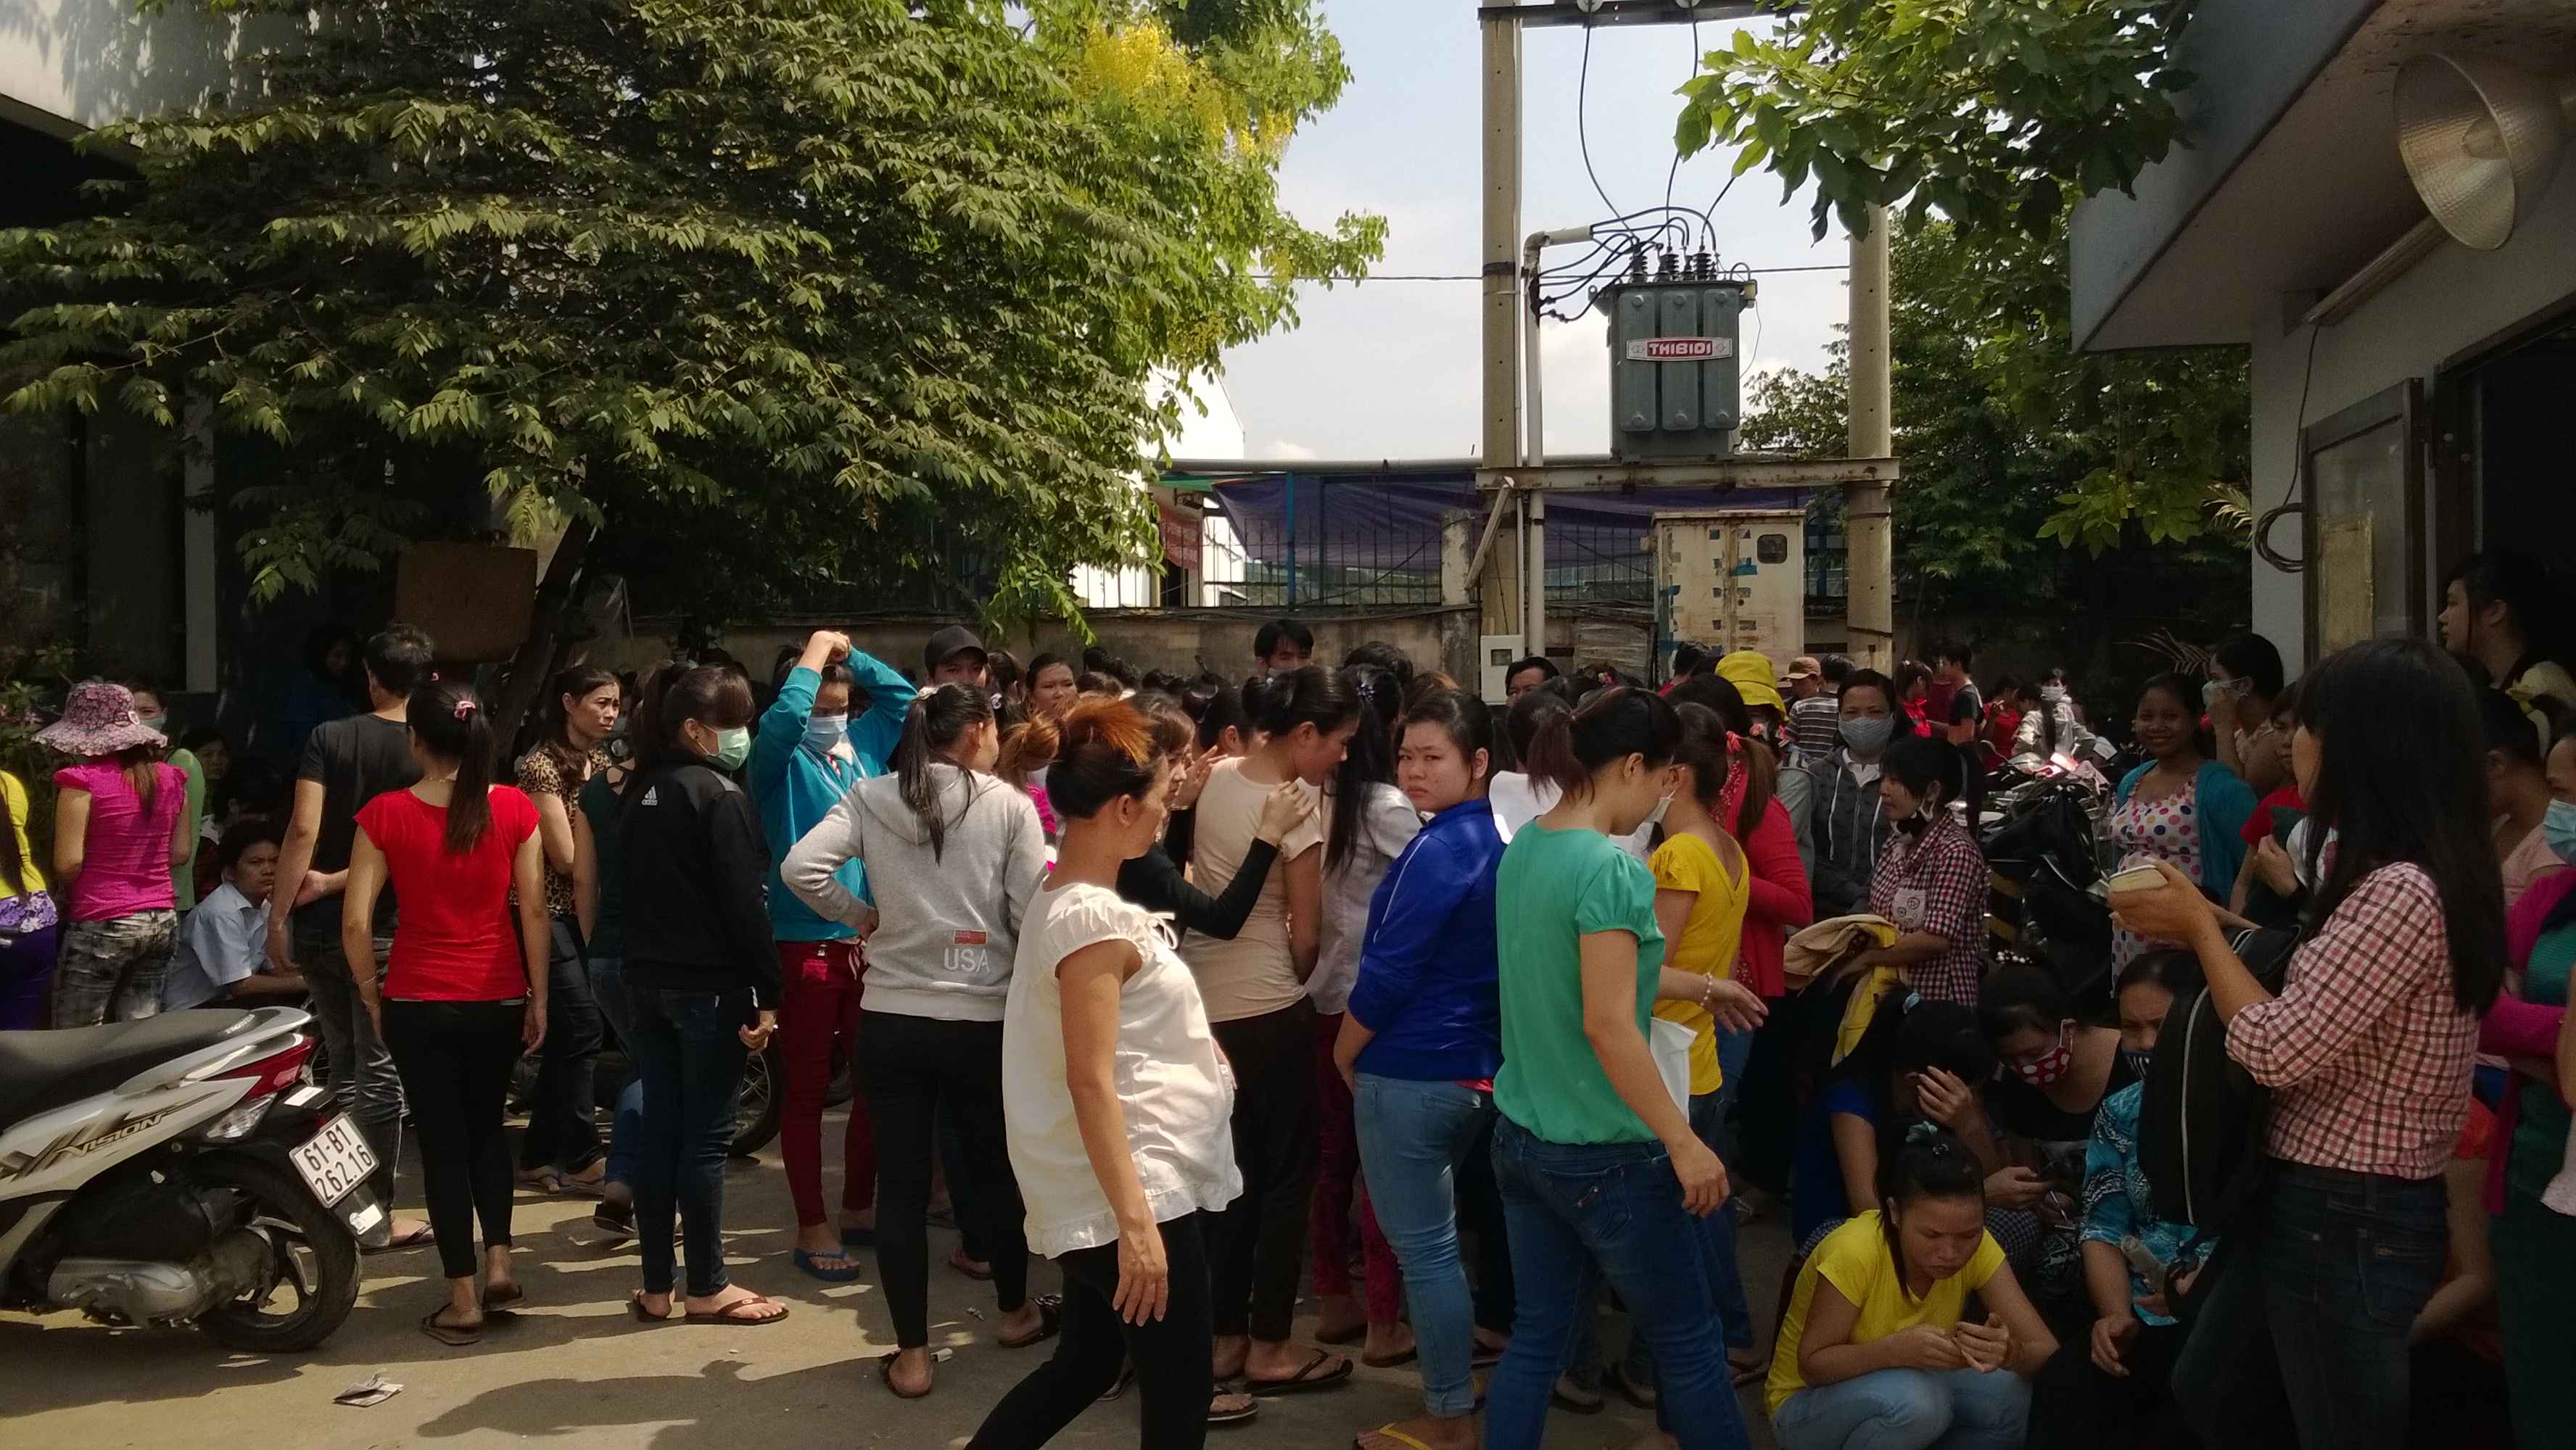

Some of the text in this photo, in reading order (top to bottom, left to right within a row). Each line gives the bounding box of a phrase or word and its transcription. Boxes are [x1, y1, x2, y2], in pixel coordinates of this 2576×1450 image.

[1648, 342, 1712, 355] THIBIDI
[944, 948, 991, 973] USA
[55, 1111, 168, 1158] VISION
[315, 1144, 372, 1201] 262.16
